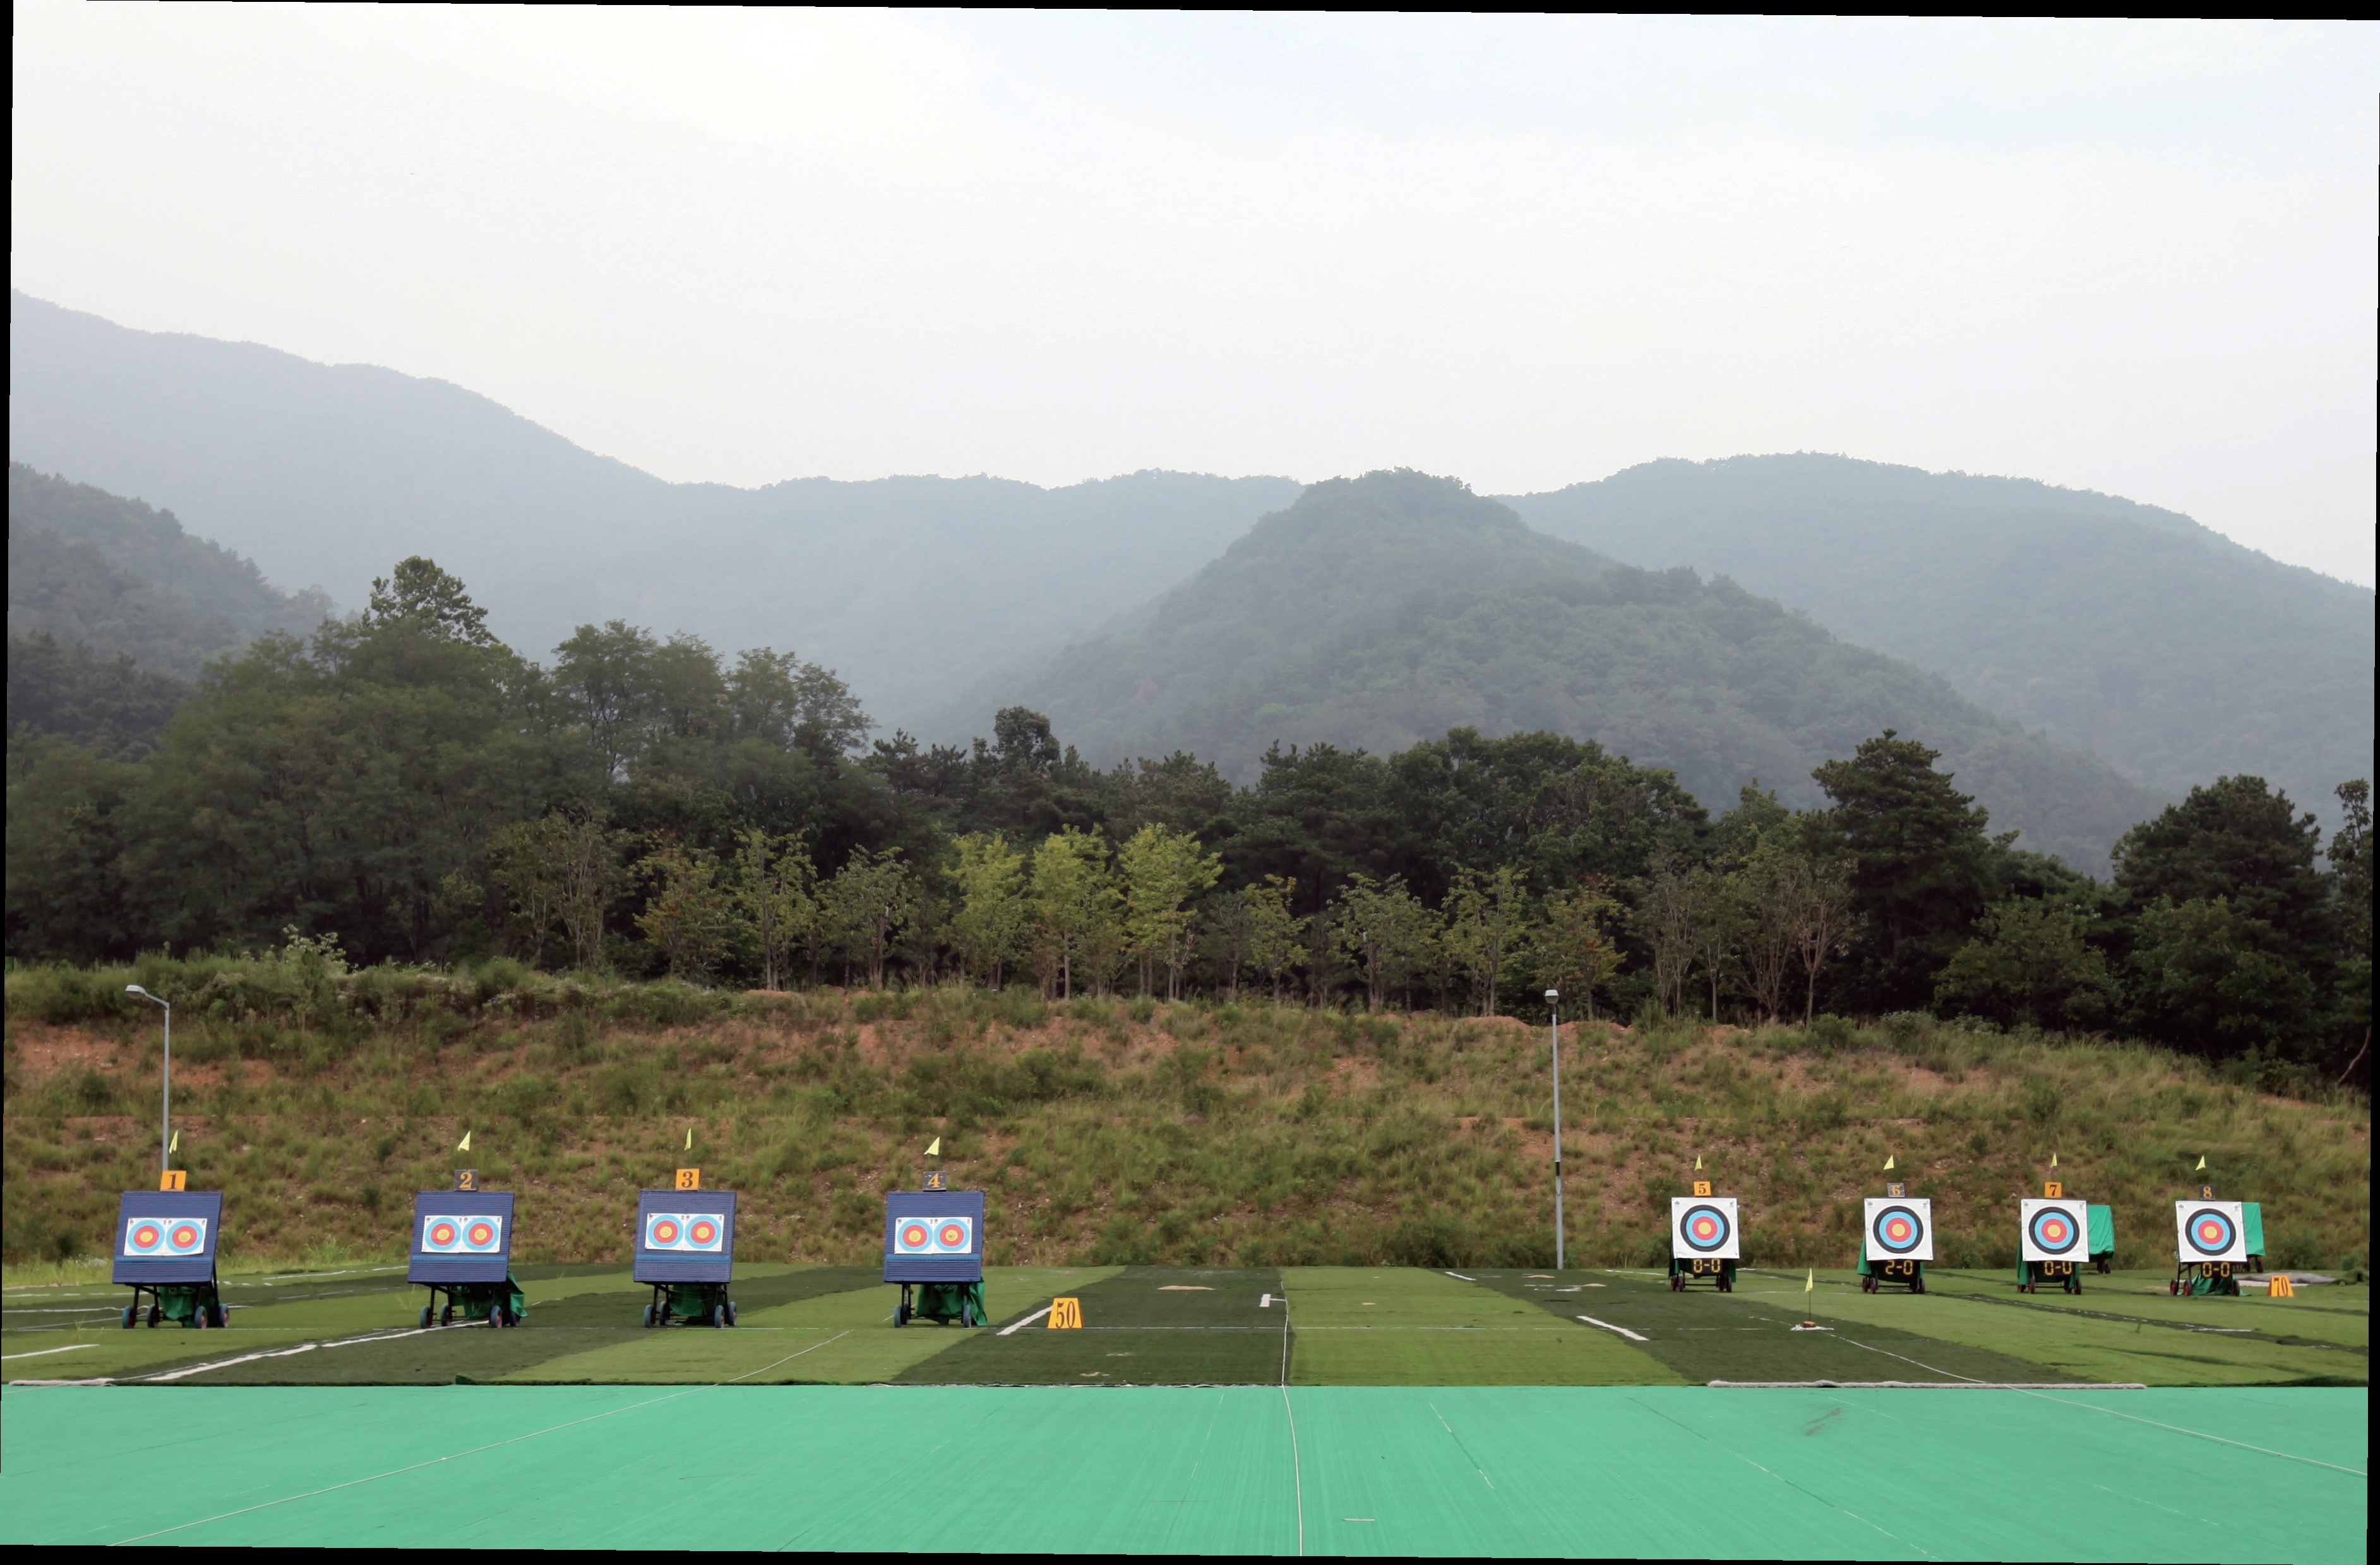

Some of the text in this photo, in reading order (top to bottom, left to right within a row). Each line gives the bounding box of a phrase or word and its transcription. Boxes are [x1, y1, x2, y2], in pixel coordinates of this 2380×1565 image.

[169, 1174, 177, 1189] 1
[459, 1172, 473, 1189] 2
[681, 1171, 693, 1188] 3
[928, 1173, 941, 1188] 4
[1698, 1184, 1706, 1194] 5
[1891, 1186, 1901, 1196] 6
[2049, 1184, 2057, 1196] 7
[2203, 1186, 2212, 1199] 8
[1693, 1259, 1720, 1273] 0-0
[1885, 1260, 1913, 1275] 2-0
[2044, 1261, 2072, 1276] 0-0
[2203, 1262, 2230, 1277] 0-0
[2273, 1277, 2288, 1297] 70
[1055, 1300, 1075, 1328] 50
